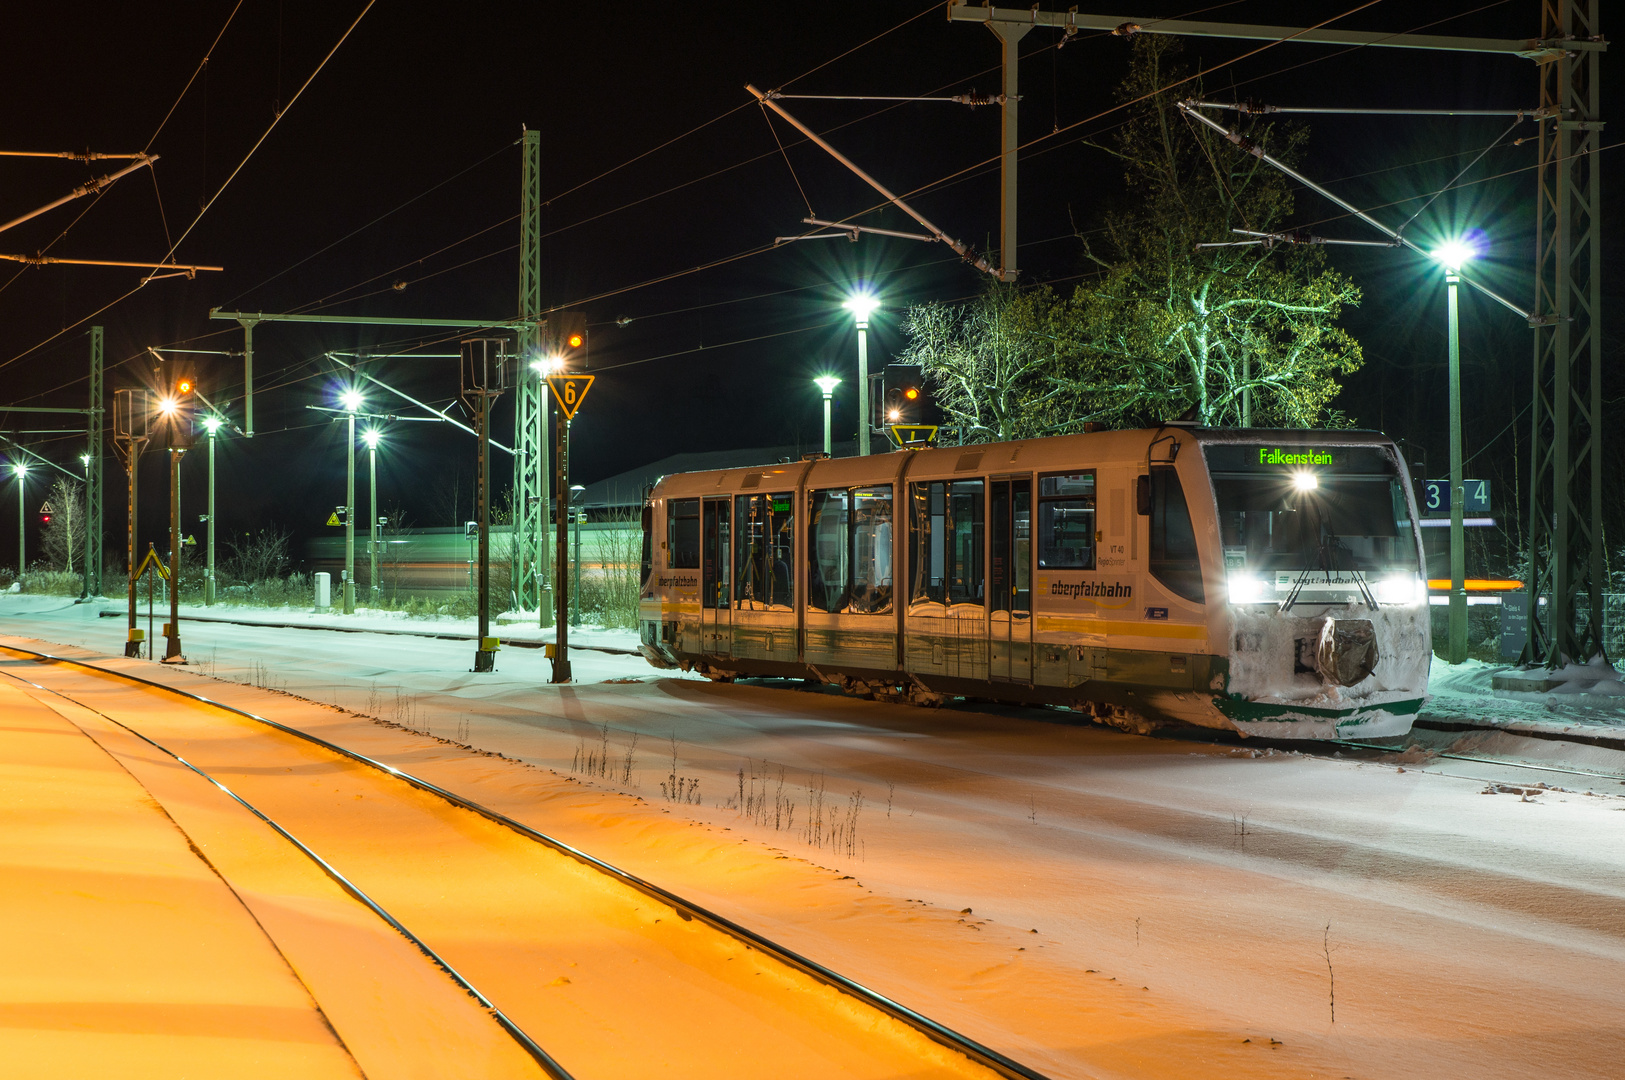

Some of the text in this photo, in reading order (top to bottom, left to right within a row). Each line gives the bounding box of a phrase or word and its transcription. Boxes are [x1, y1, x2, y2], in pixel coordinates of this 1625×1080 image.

[564, 382, 576, 405] 6
[1260, 448, 1332, 465] Falkenstein
[1427, 484, 1440, 508] 3
[1474, 481, 1487, 504] 4
[1110, 545, 1124, 553] VT 40
[1052, 580, 1131, 599] oberpfalzbahn
